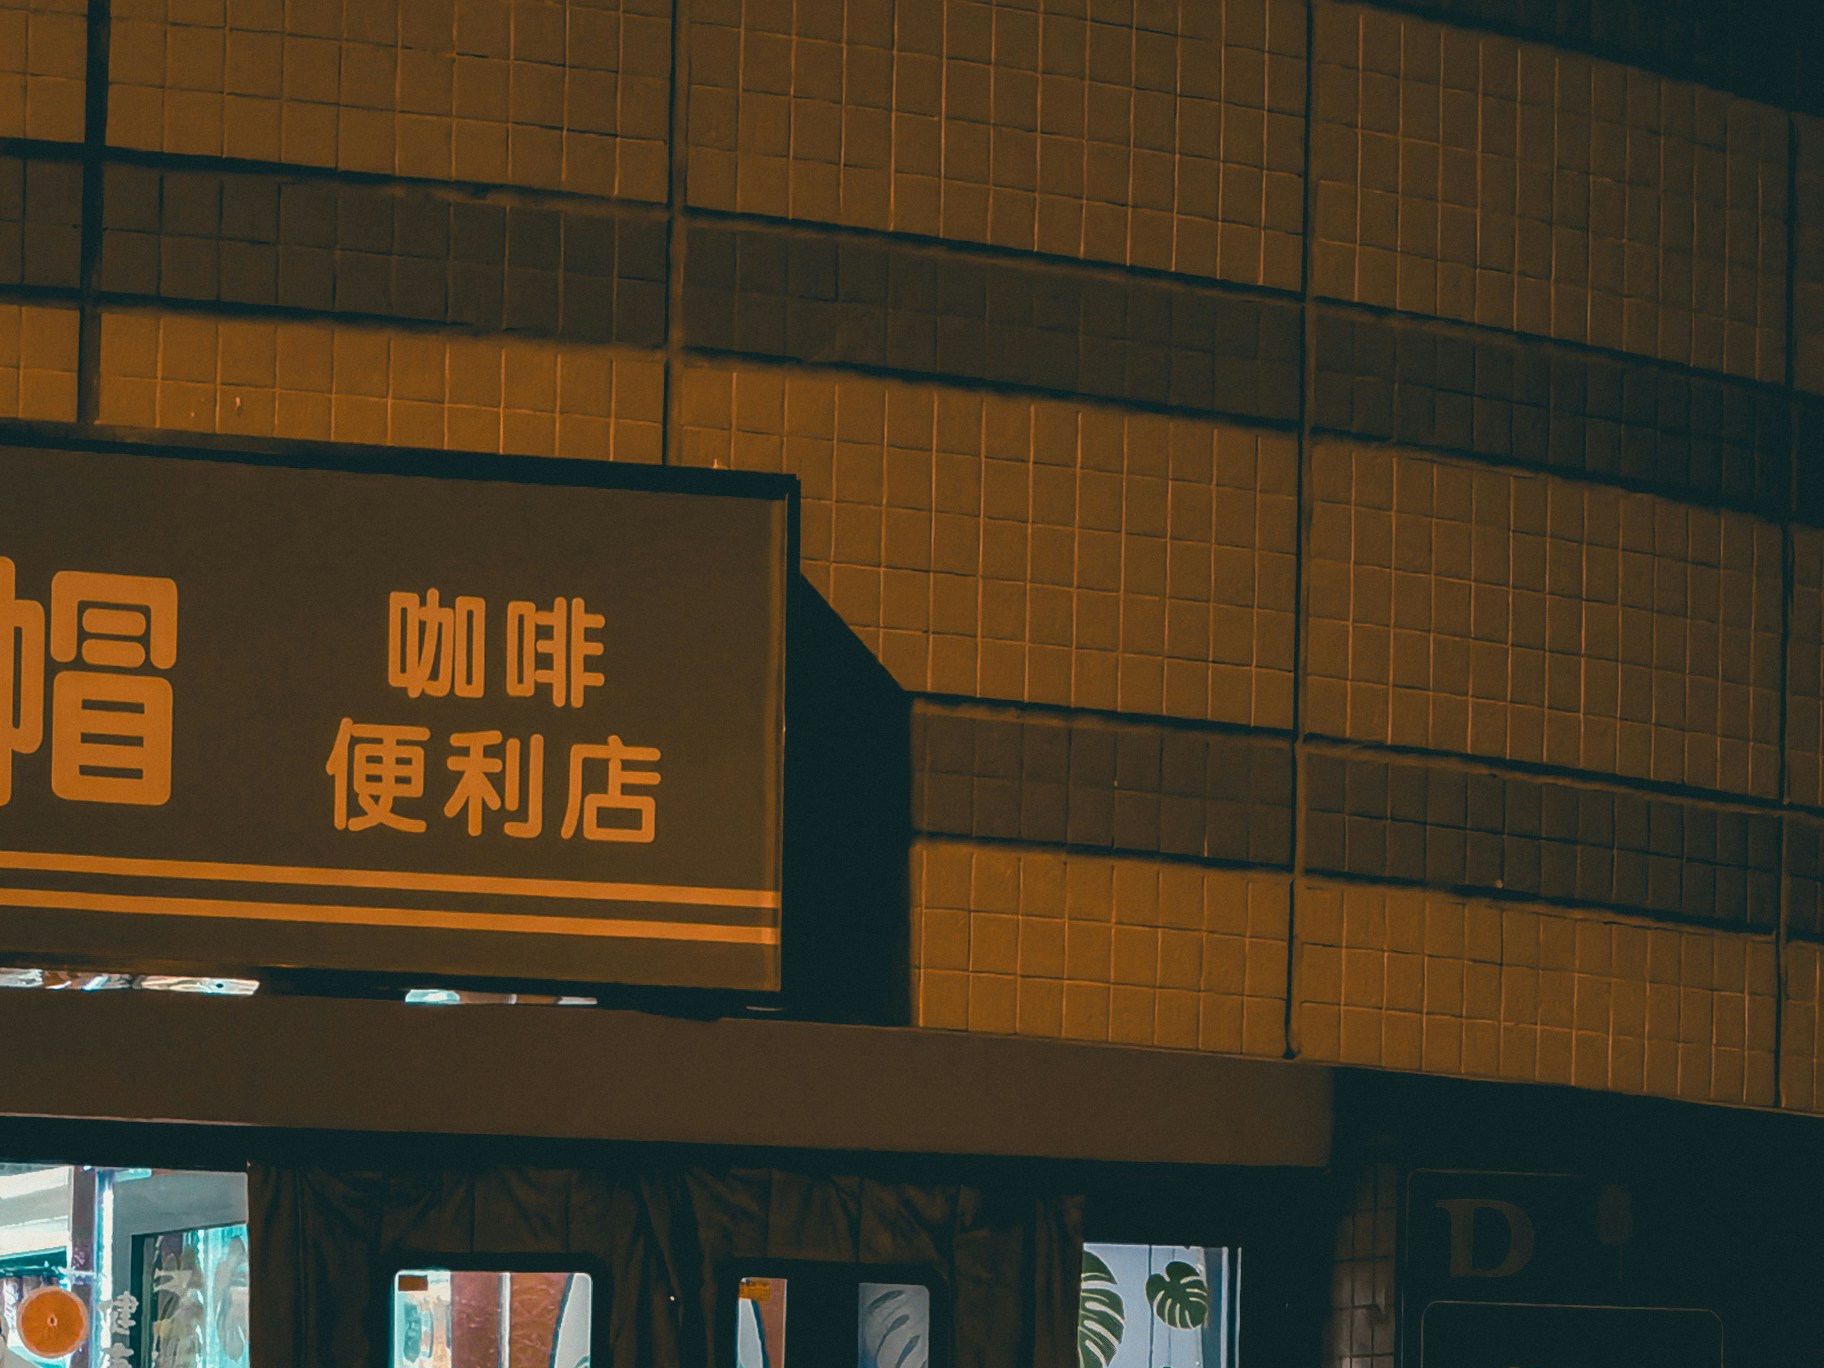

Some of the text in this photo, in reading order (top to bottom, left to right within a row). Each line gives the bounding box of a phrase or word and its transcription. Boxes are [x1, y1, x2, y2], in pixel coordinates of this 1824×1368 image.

[387, 588, 606, 709] 咖啡
[326, 718, 662, 843] 便利店
[1436, 1199, 1534, 1278] D
